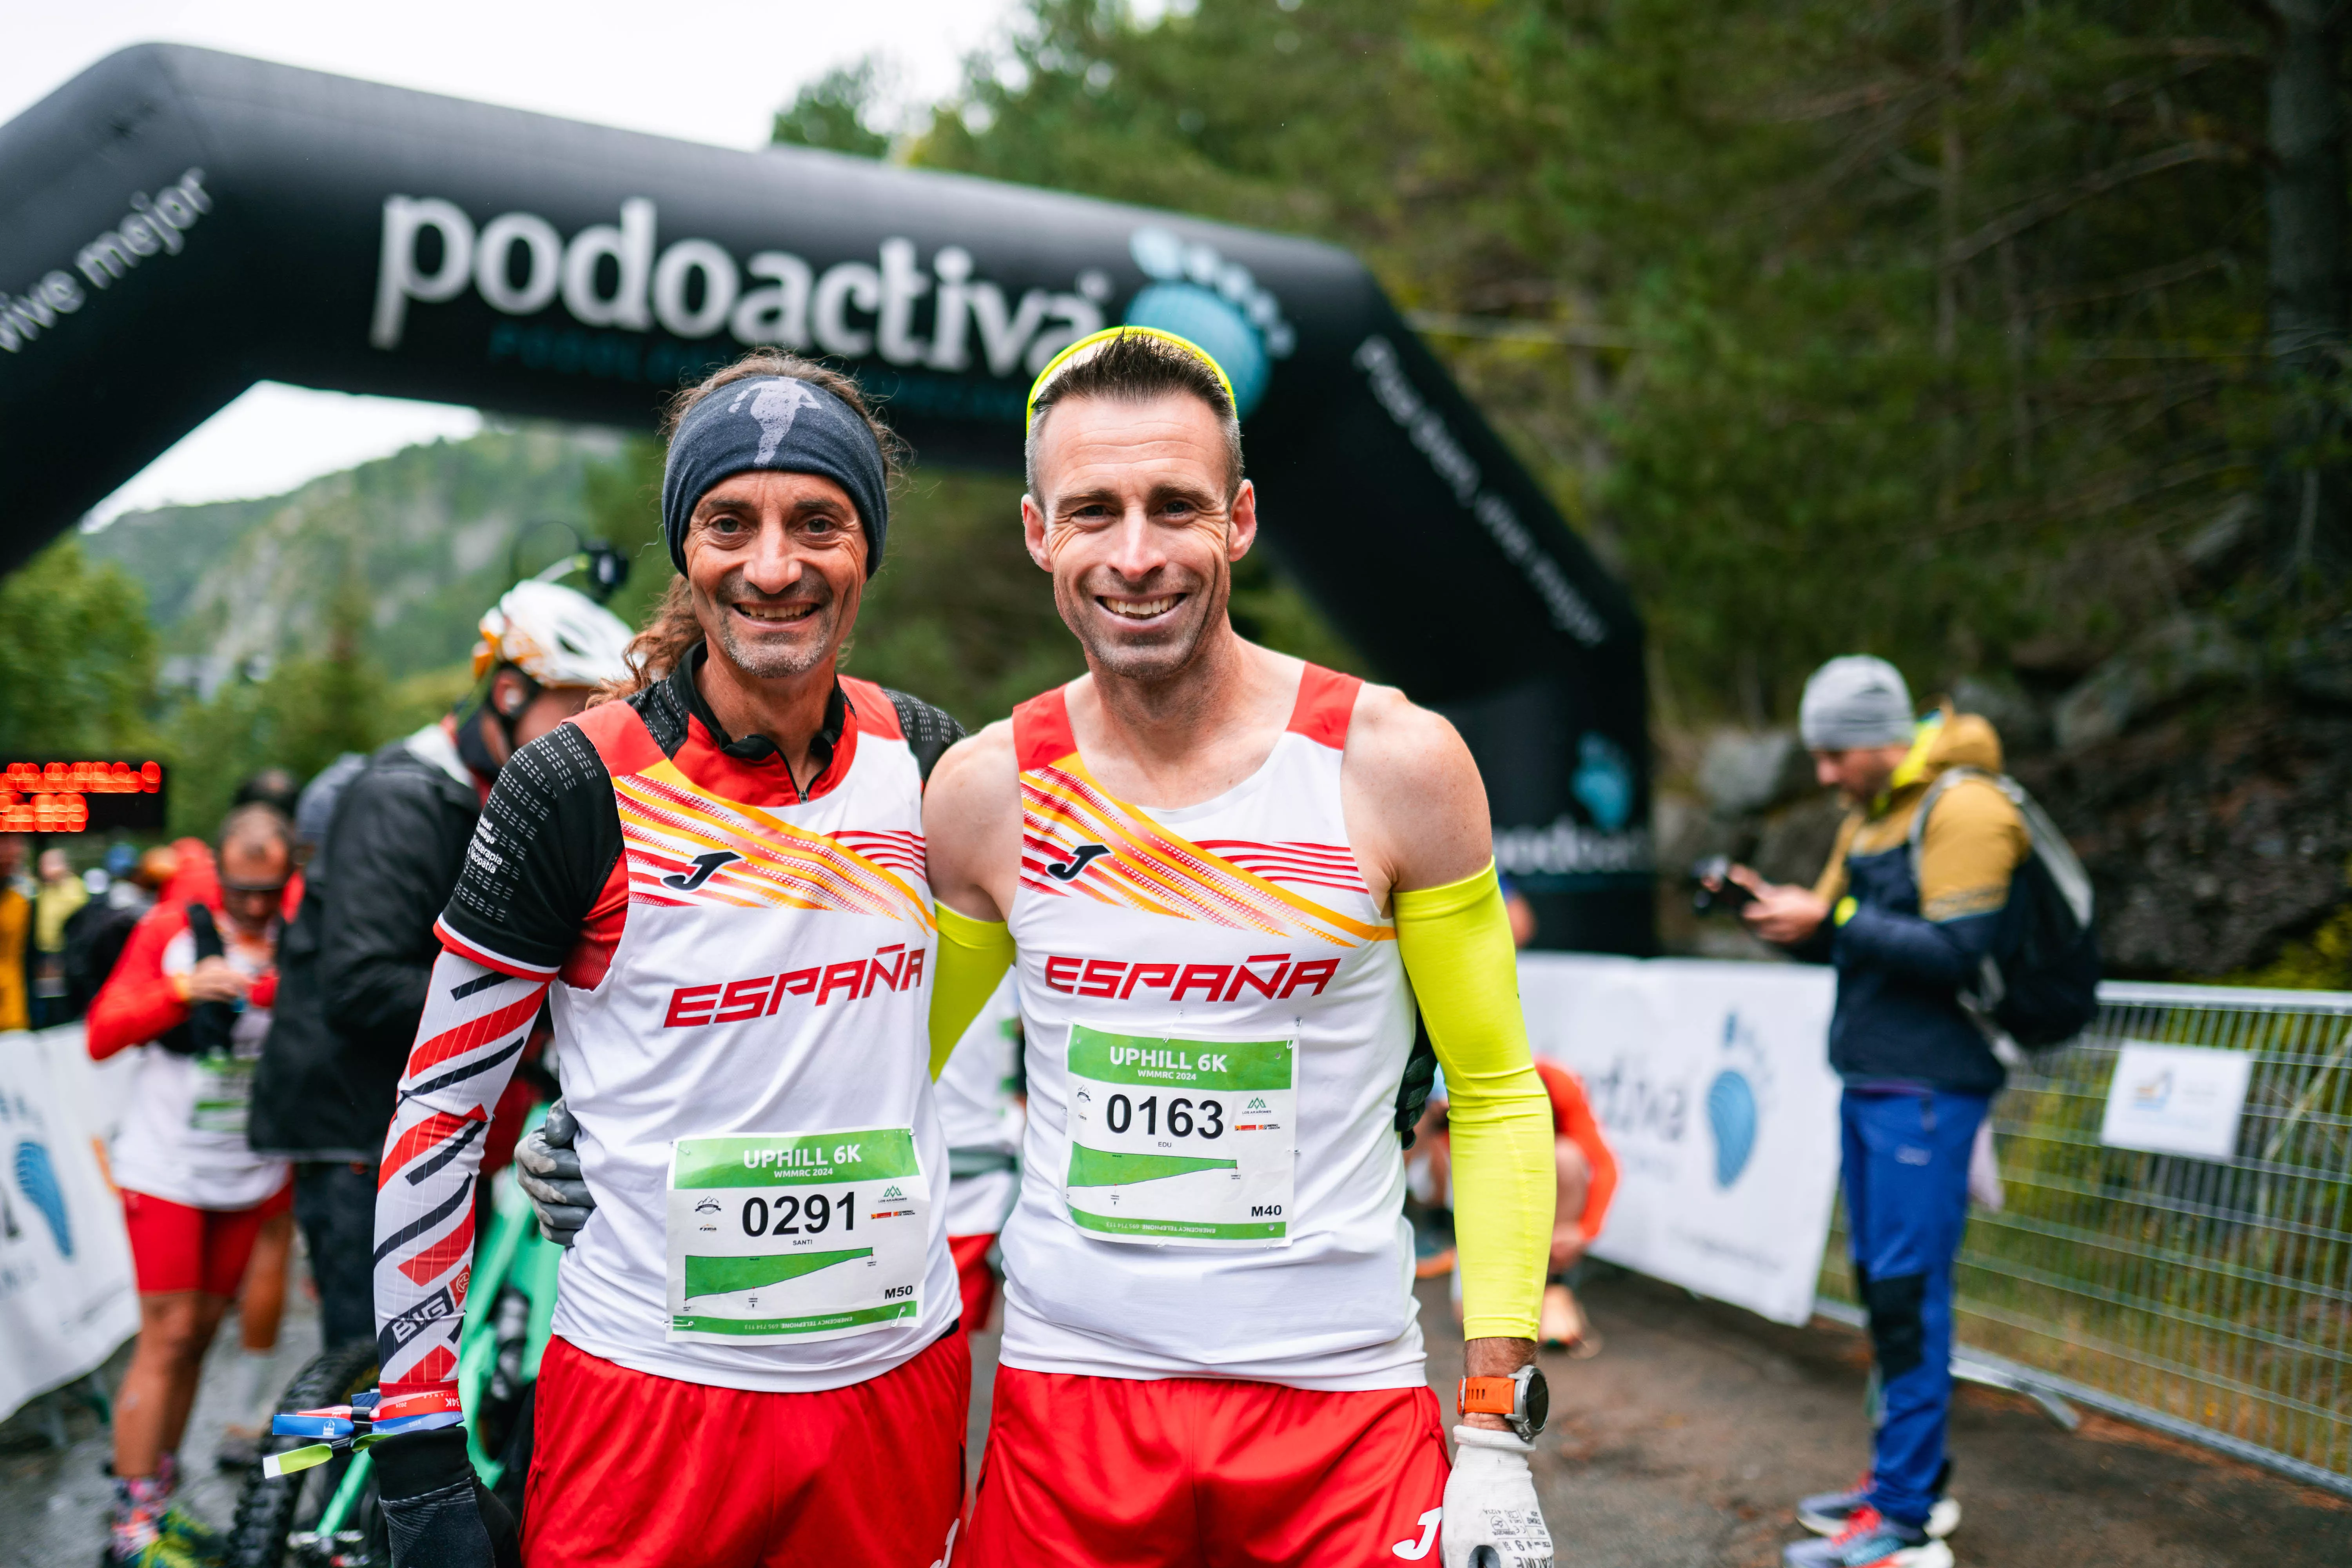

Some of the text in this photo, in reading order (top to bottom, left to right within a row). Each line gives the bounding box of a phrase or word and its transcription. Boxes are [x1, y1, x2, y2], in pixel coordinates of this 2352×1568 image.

[74, 166, 212, 289] mejor
[369, 194, 1106, 379] podoactiva
[663, 943, 926, 1028] ESPAÑA
[1045, 953, 1341, 1002] ESPAÑA
[1110, 1046, 1227, 1073] UPHILL 6K
[1138, 1070, 1197, 1080] WMMRC 2024
[1106, 1094, 1223, 1140] 0163
[744, 1144, 862, 1169] UPHILL 6K
[774, 1168, 833, 1178] WMMRC 2024
[742, 1191, 855, 1237] 0291
[1251, 1205, 1282, 1216] M40
[884, 1285, 913, 1299] M50
[392, 1296, 447, 1343] BIG
[818, 1316, 853, 1325] EMERGENCY
[445, 1398, 460, 1407] 34K
